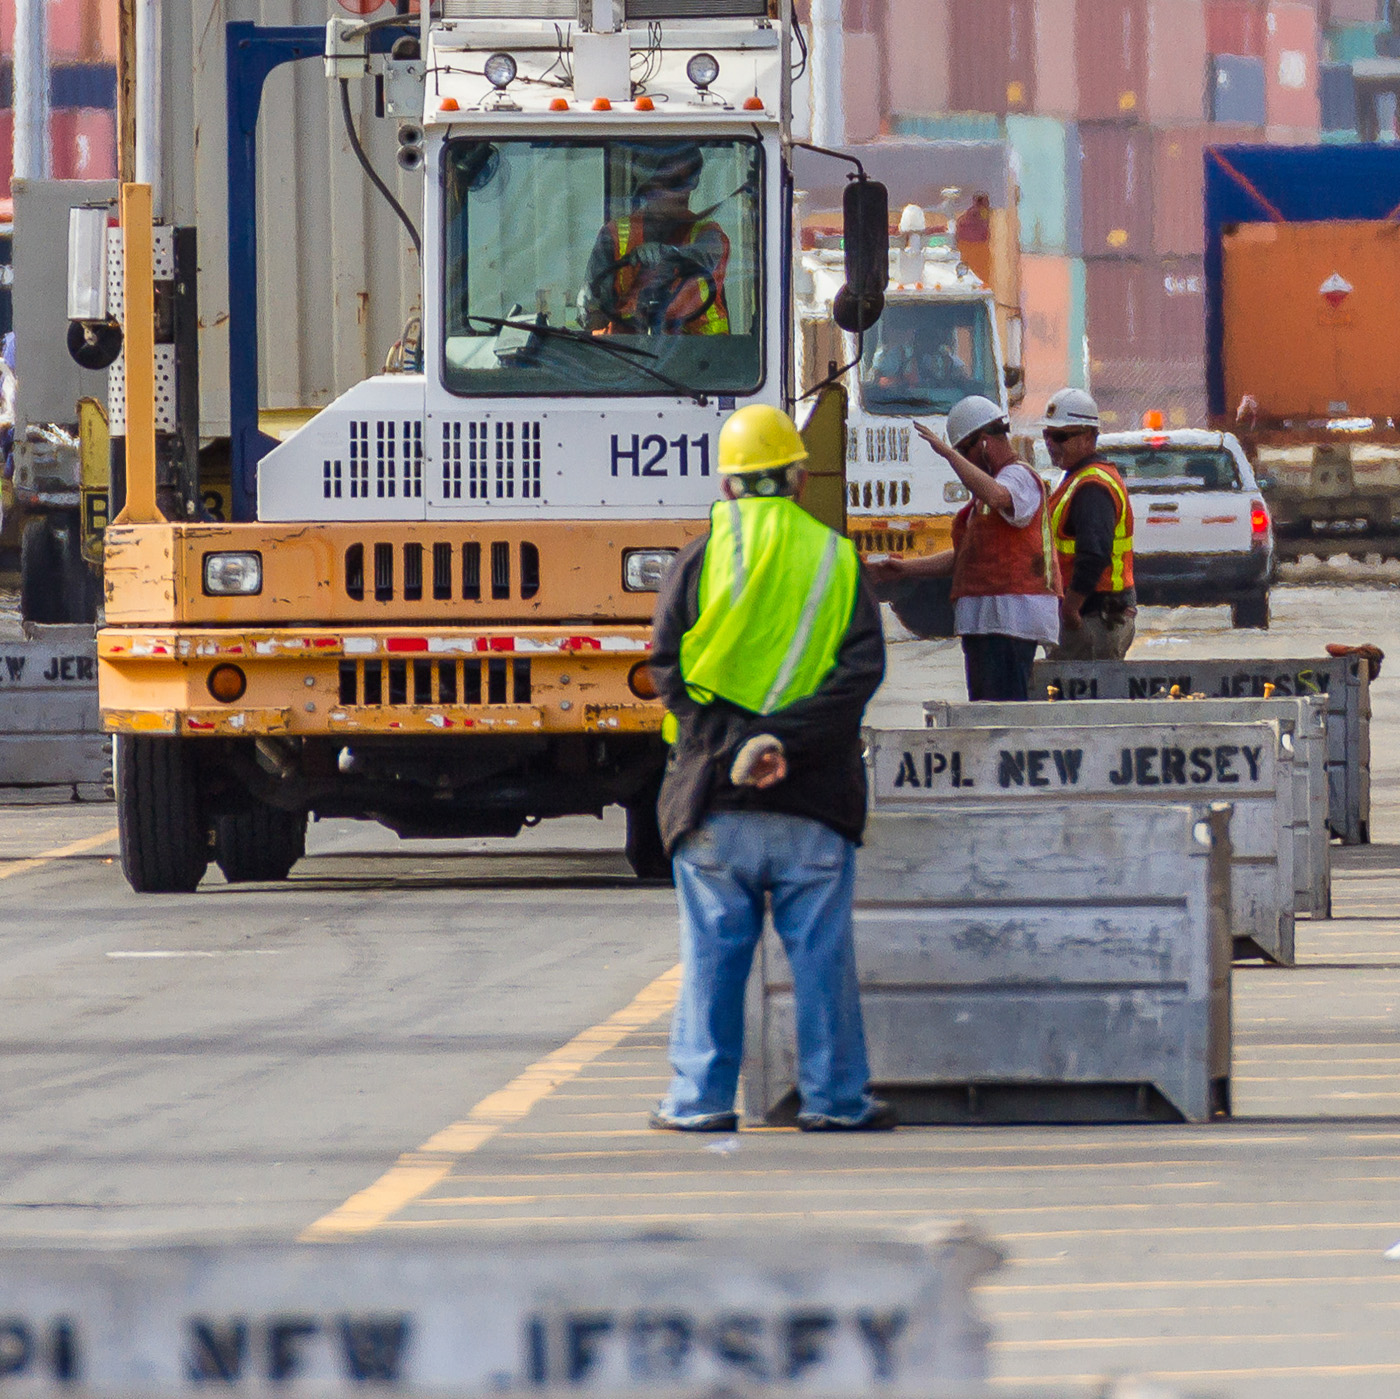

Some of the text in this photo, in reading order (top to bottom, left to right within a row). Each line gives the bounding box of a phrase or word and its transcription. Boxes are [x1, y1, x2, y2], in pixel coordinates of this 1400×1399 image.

[610, 432, 710, 477] H211
[43, 655, 95, 681] JER
[893, 744, 1263, 789] APL NEW JERSEY
